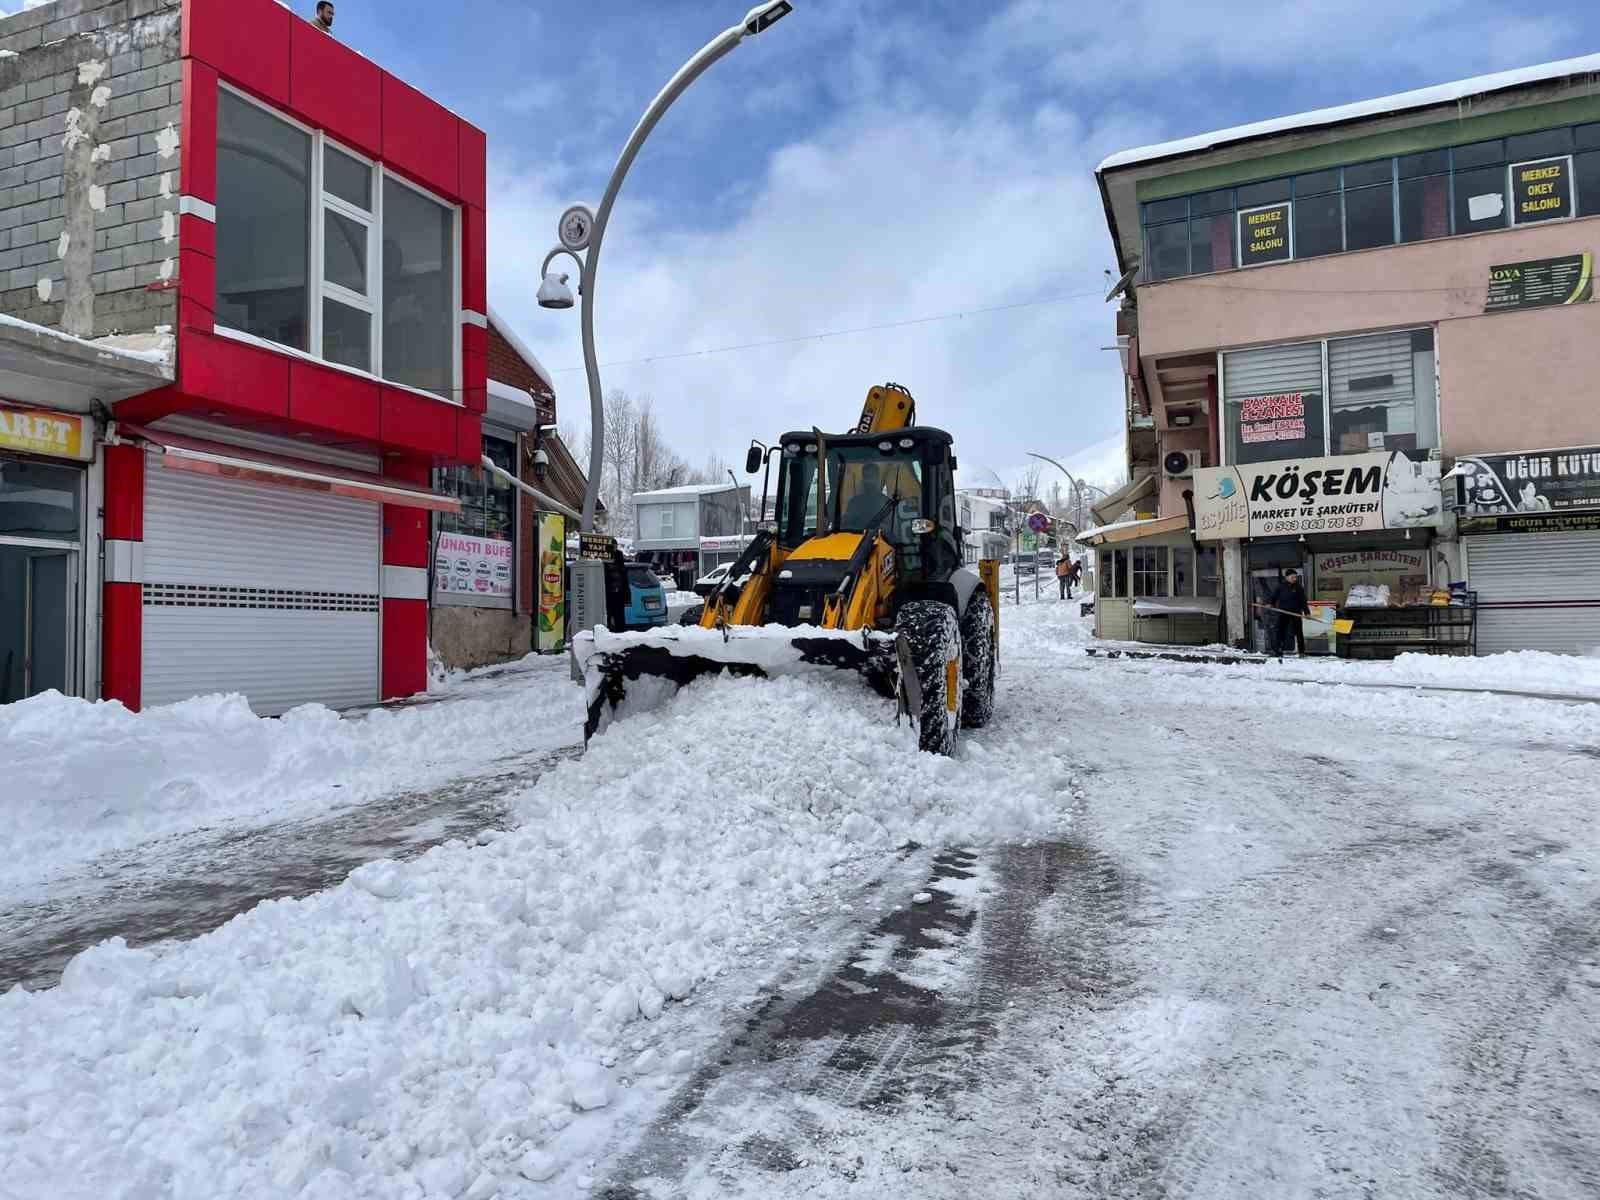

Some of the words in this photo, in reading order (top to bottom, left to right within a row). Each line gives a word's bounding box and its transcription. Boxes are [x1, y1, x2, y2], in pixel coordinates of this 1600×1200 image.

[1521, 166, 1561, 182] MERKEZ
[1528, 182, 1554, 196] OKEY
[1521, 197, 1561, 213] SALONU
[1248, 211, 1281, 224] MERKEZ
[1254, 226, 1277, 238] OKEY
[1249, 238, 1283, 252] SALONU
[1506, 456, 1552, 480] UĞUR
[1250, 465, 1383, 505] KÖŞEM
[1251, 508, 1298, 520] MARKET
[1300, 506, 1314, 517] VE
[1317, 502, 1379, 518] ŞARKÜTERİ
[1264, 522, 1274, 533] 0
[1327, 517, 1345, 529] 78
[1320, 553, 1358, 571] KÖŞEM
